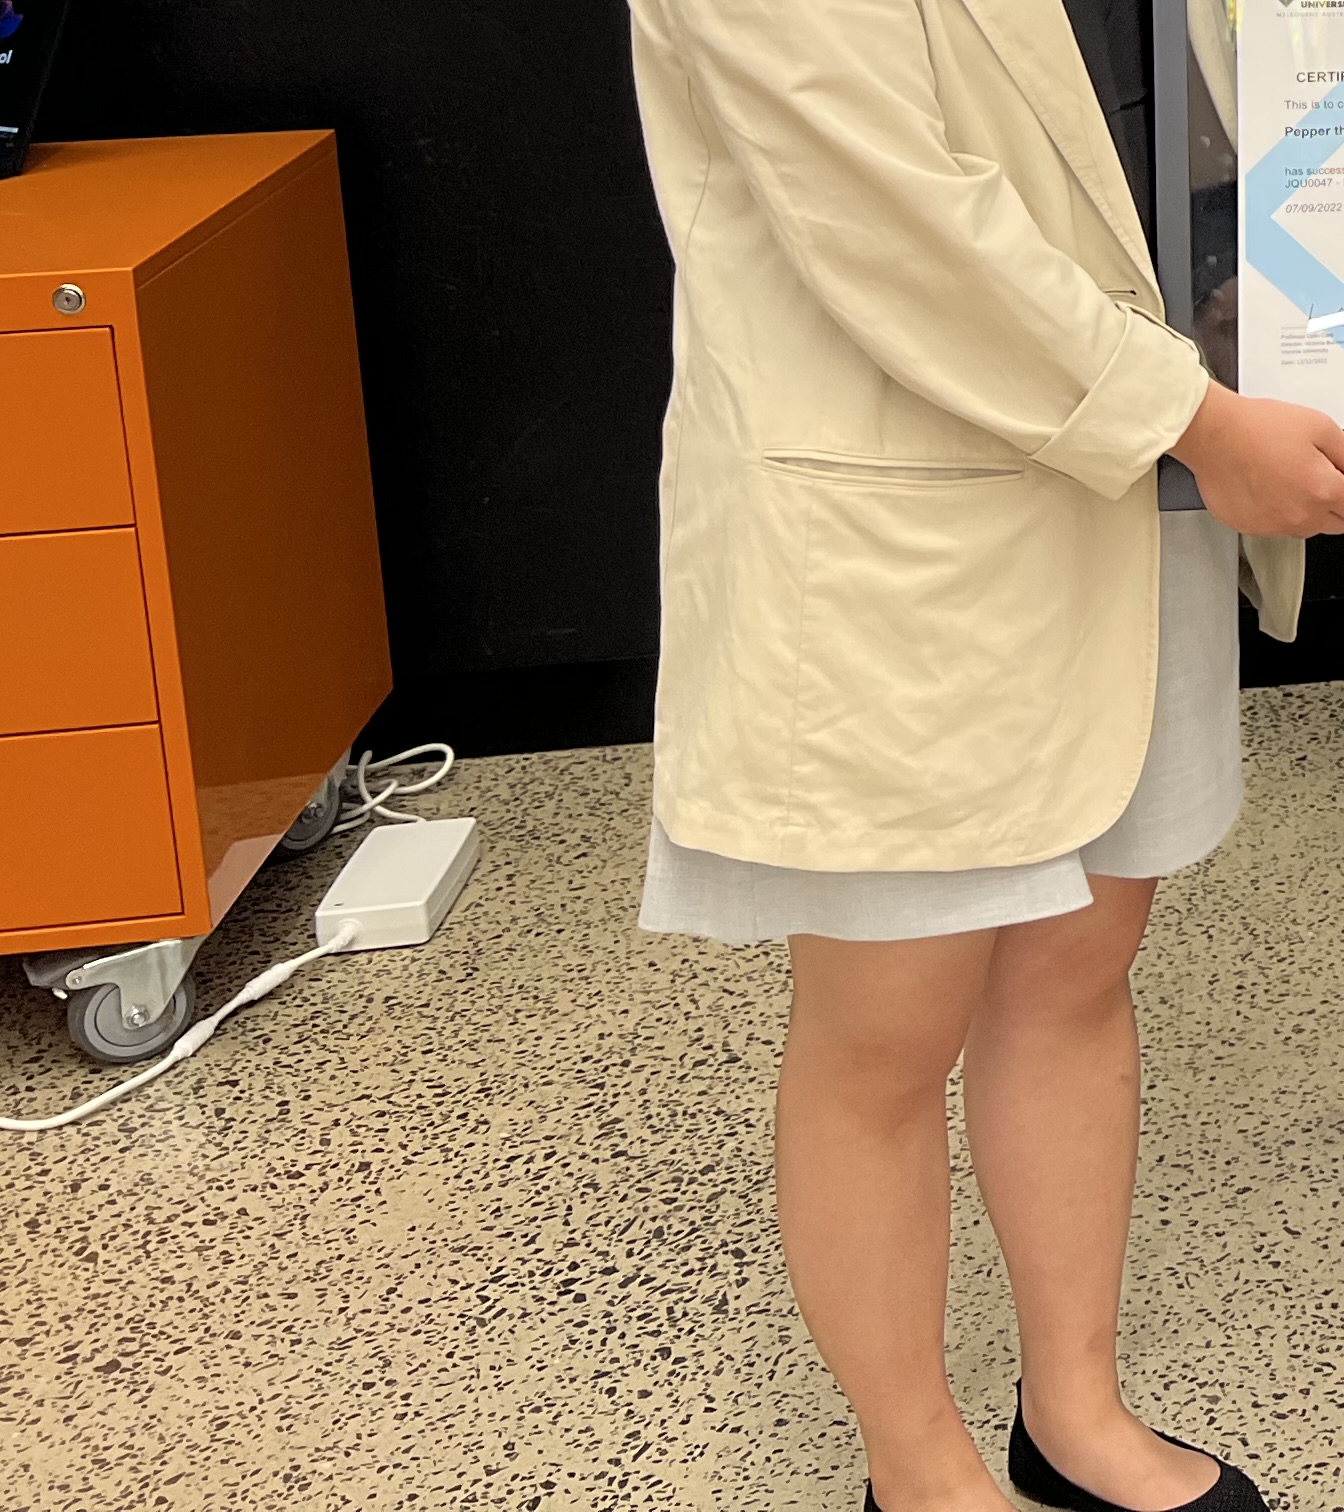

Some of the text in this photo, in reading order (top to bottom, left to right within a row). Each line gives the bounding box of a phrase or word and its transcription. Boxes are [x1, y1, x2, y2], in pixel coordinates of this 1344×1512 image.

[1284, 99, 1308, 110] This
[1311, 99, 1320, 110] is
[1323, 99, 1334, 110] to
[1285, 125, 1331, 139] Pepper
[1284, 166, 1304, 176] has
[1285, 177, 1333, 189] JQU0047
[1285, 201, 1343, 214] 07/09/2022
